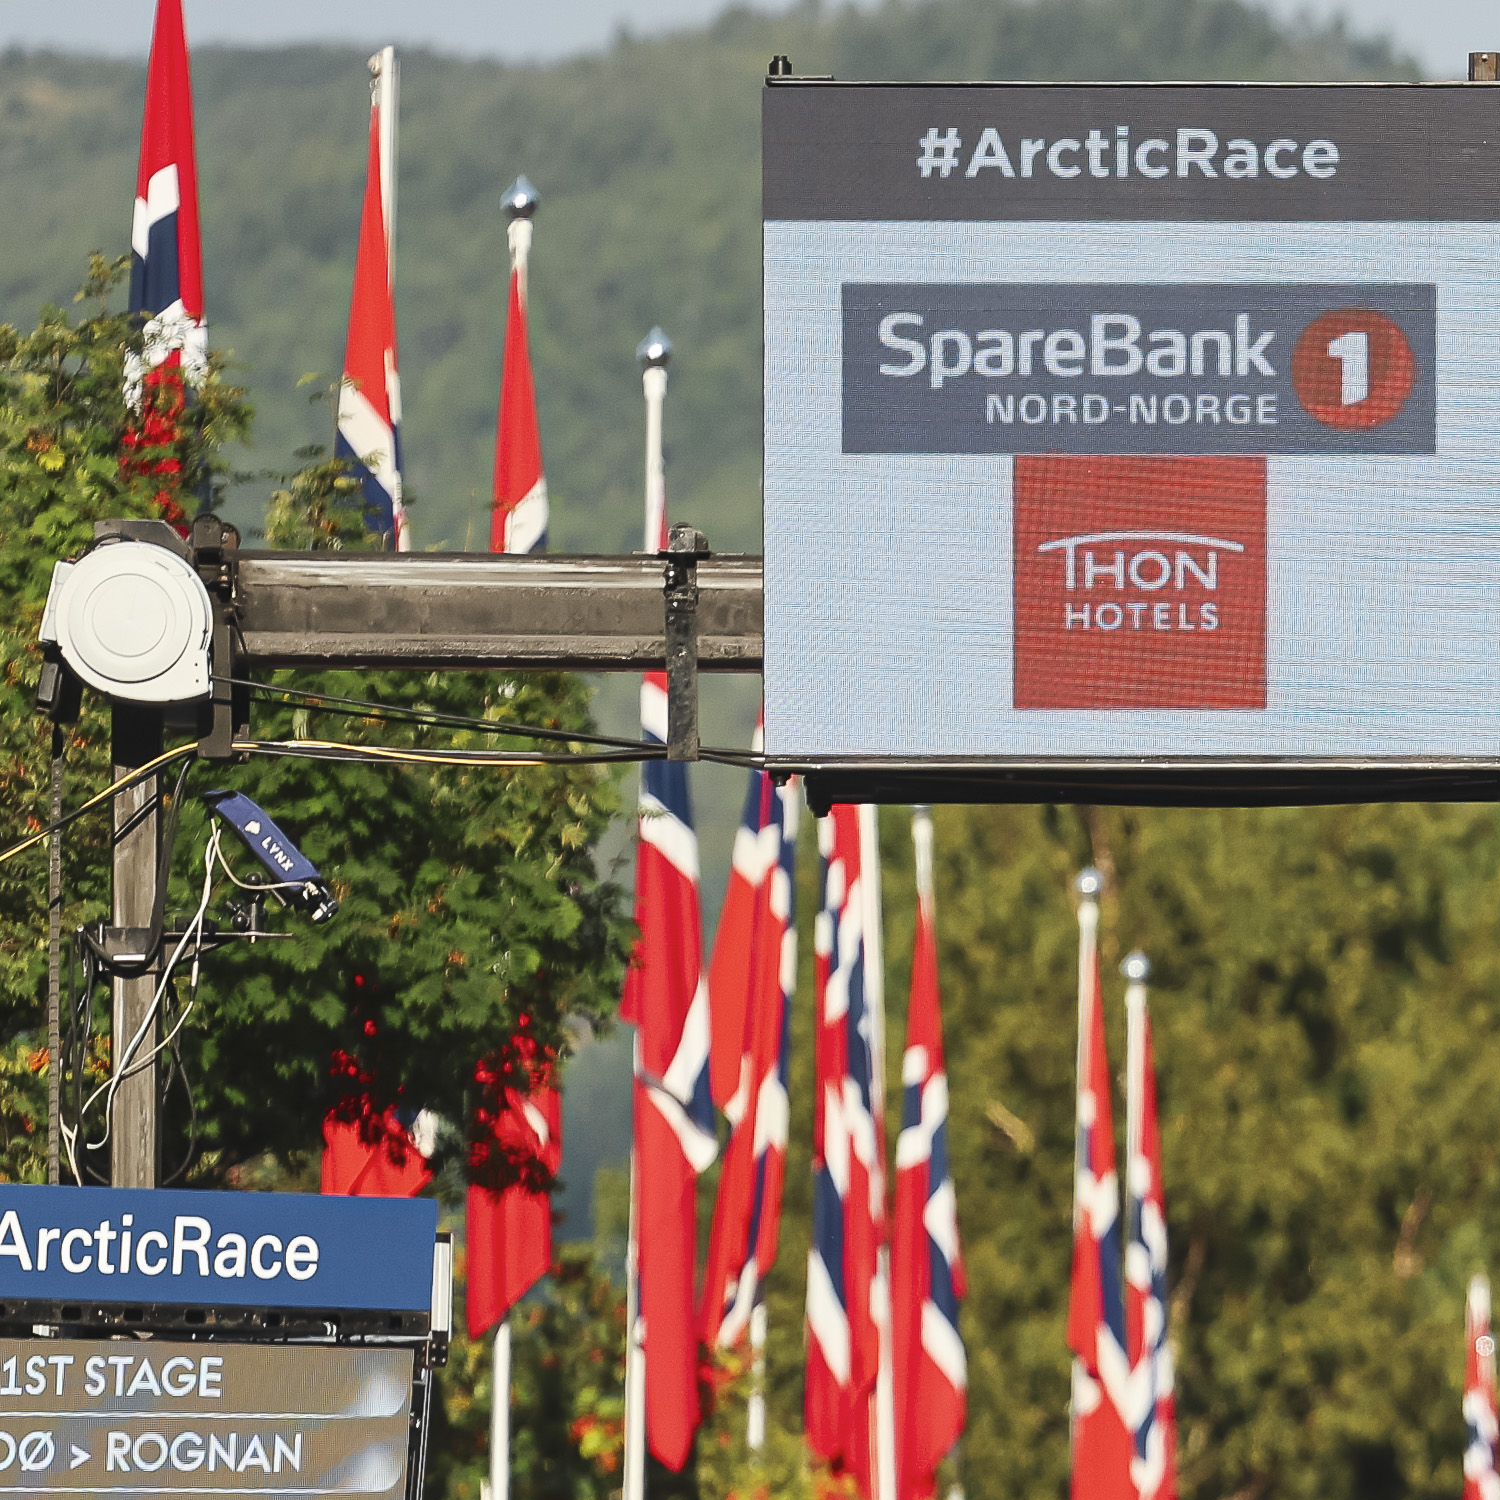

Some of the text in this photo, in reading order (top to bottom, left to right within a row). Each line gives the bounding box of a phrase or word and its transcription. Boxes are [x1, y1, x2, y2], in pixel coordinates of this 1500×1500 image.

[917, 126, 1341, 179] #ArcticRace
[878, 312, 1277, 389] SpareBank
[985, 394, 1278, 425] NORD-NORGE
[1045, 534, 1235, 590] THON
[1064, 602, 1219, 632] HOTELS
[261, 835, 294, 872] LYNX
[0, 1210, 320, 1281] ArcticRace
[2, 1356, 224, 1398] 1ST STAGE
[106, 1431, 303, 1473] ROGNAN
